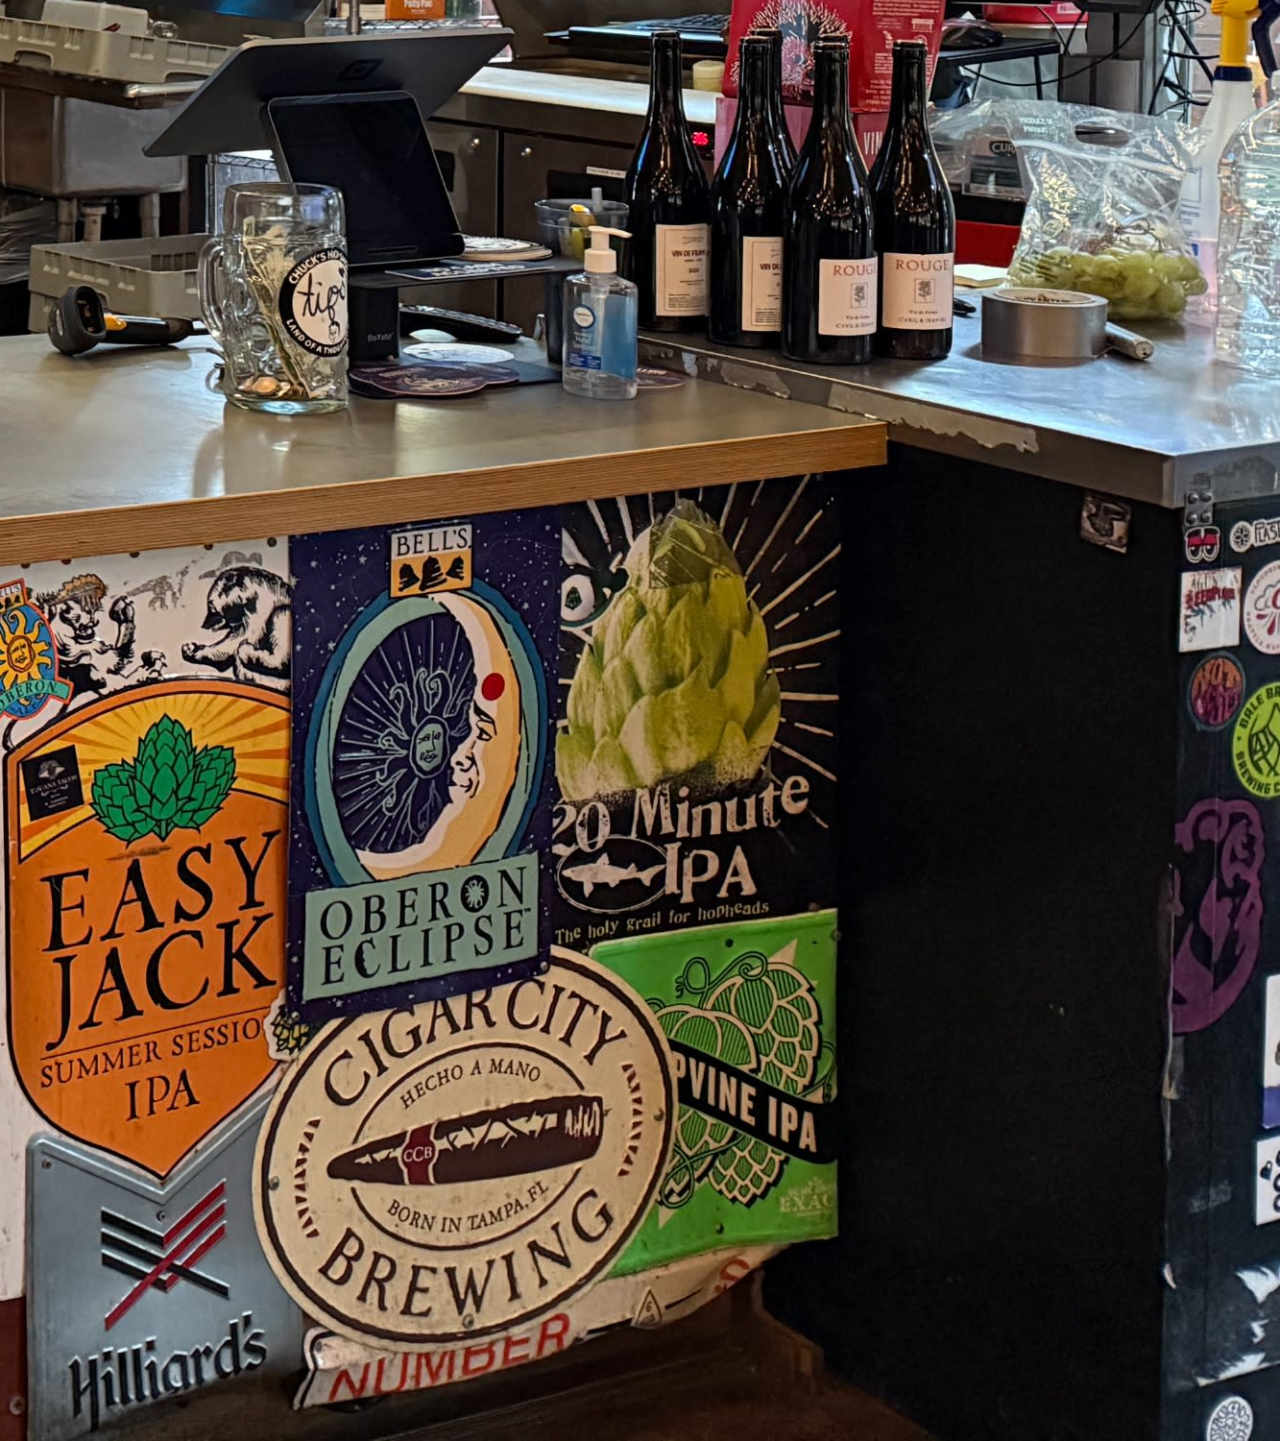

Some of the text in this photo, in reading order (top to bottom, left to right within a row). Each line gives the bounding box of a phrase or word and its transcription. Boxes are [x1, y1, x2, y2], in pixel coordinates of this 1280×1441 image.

[896, 258, 950, 273] ROUGE
[394, 527, 473, 558] BELL'S
[632, 774, 810, 839] Minute
[40, 828, 281, 952] EASY
[319, 865, 528, 940] OBERON
[664, 841, 758, 904] IPA
[321, 909, 525, 986] ECLIPSE
[555, 900, 770, 946] The holy grail for hopheads
[45, 912, 277, 1052] JACK
[41, 1016, 265, 1088] SUMMER SESSIO
[323, 978, 627, 1107] CIGAR CITY
[125, 1069, 201, 1122] IPA
[400, 1058, 541, 1110] HECHO A MANO
[672, 1051, 817, 1153] PVINE IPA
[403, 1146, 433, 1165] CCB
[387, 1180, 549, 1233] BORN IN TAMPA, FL
[318, 1188, 615, 1319] BREWING
[69, 1311, 269, 1432] Hilliard's
[328, 1311, 571, 1402] NUMBER
